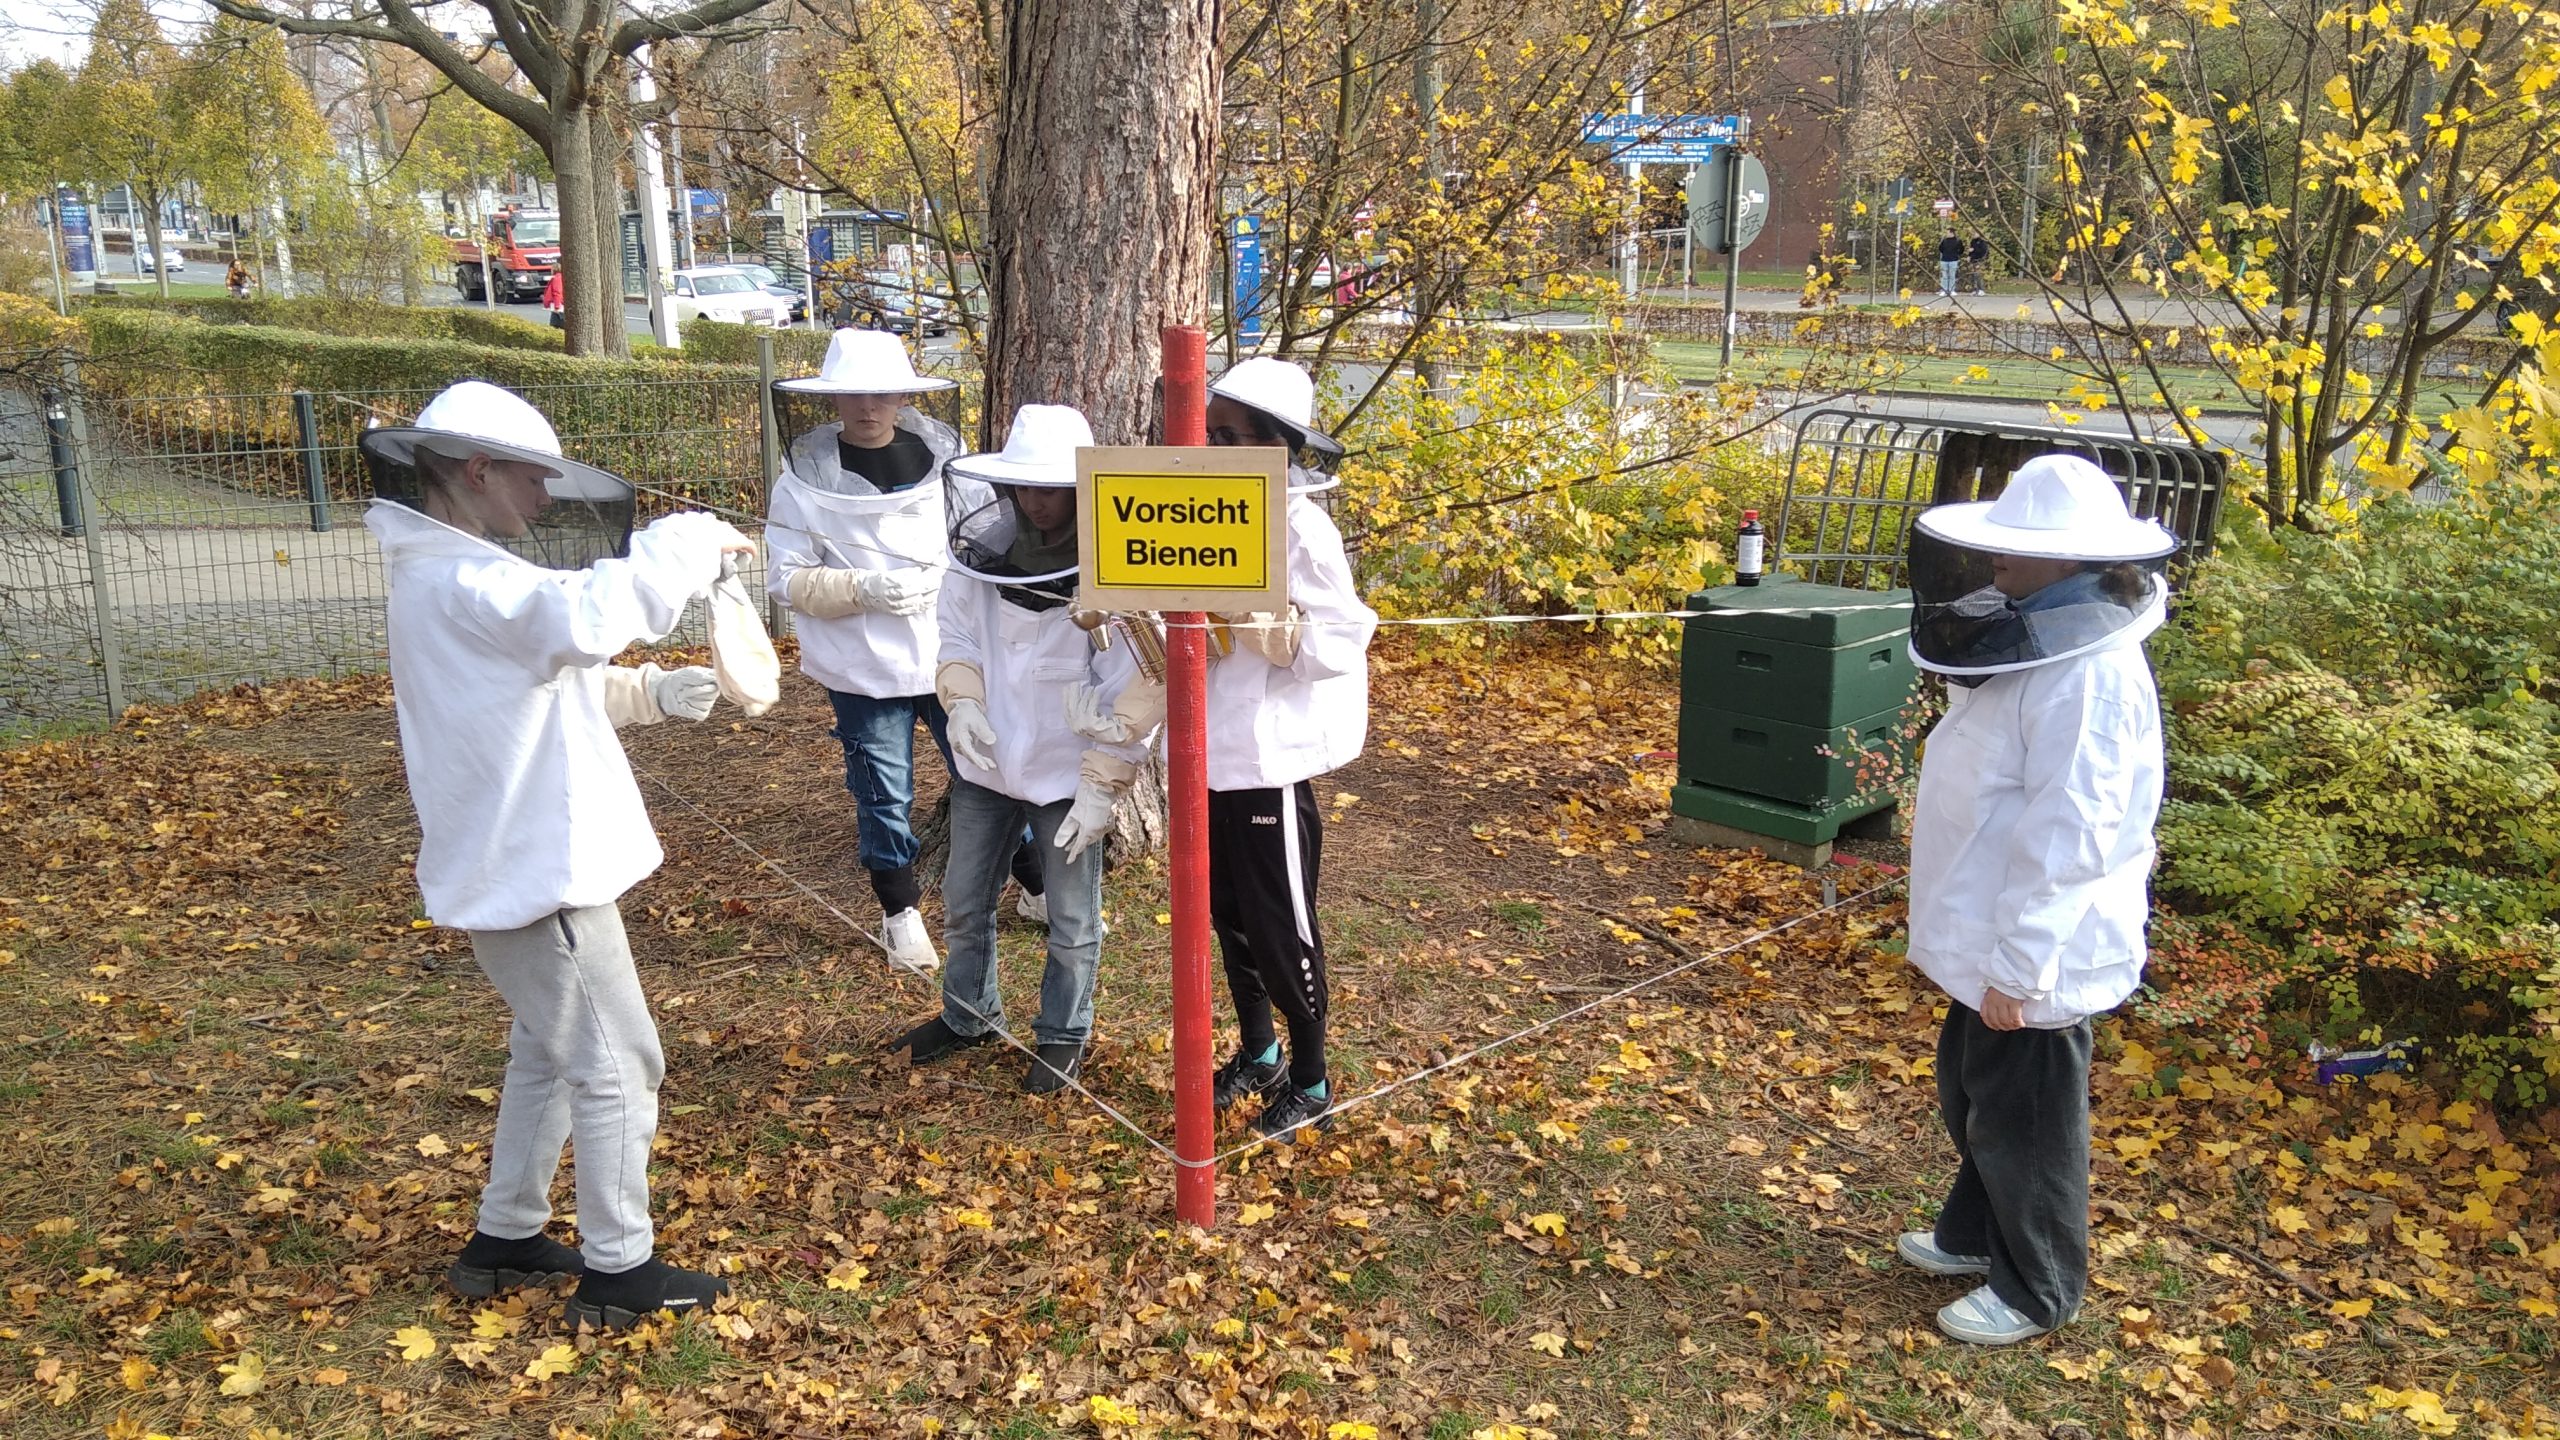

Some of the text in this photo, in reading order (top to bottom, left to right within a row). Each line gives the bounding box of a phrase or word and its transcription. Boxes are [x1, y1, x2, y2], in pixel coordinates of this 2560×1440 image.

[1112, 495, 1250, 525] Vorsicht
[1126, 538, 1238, 567] Bienen
[1251, 815, 1277, 825] JAKO
